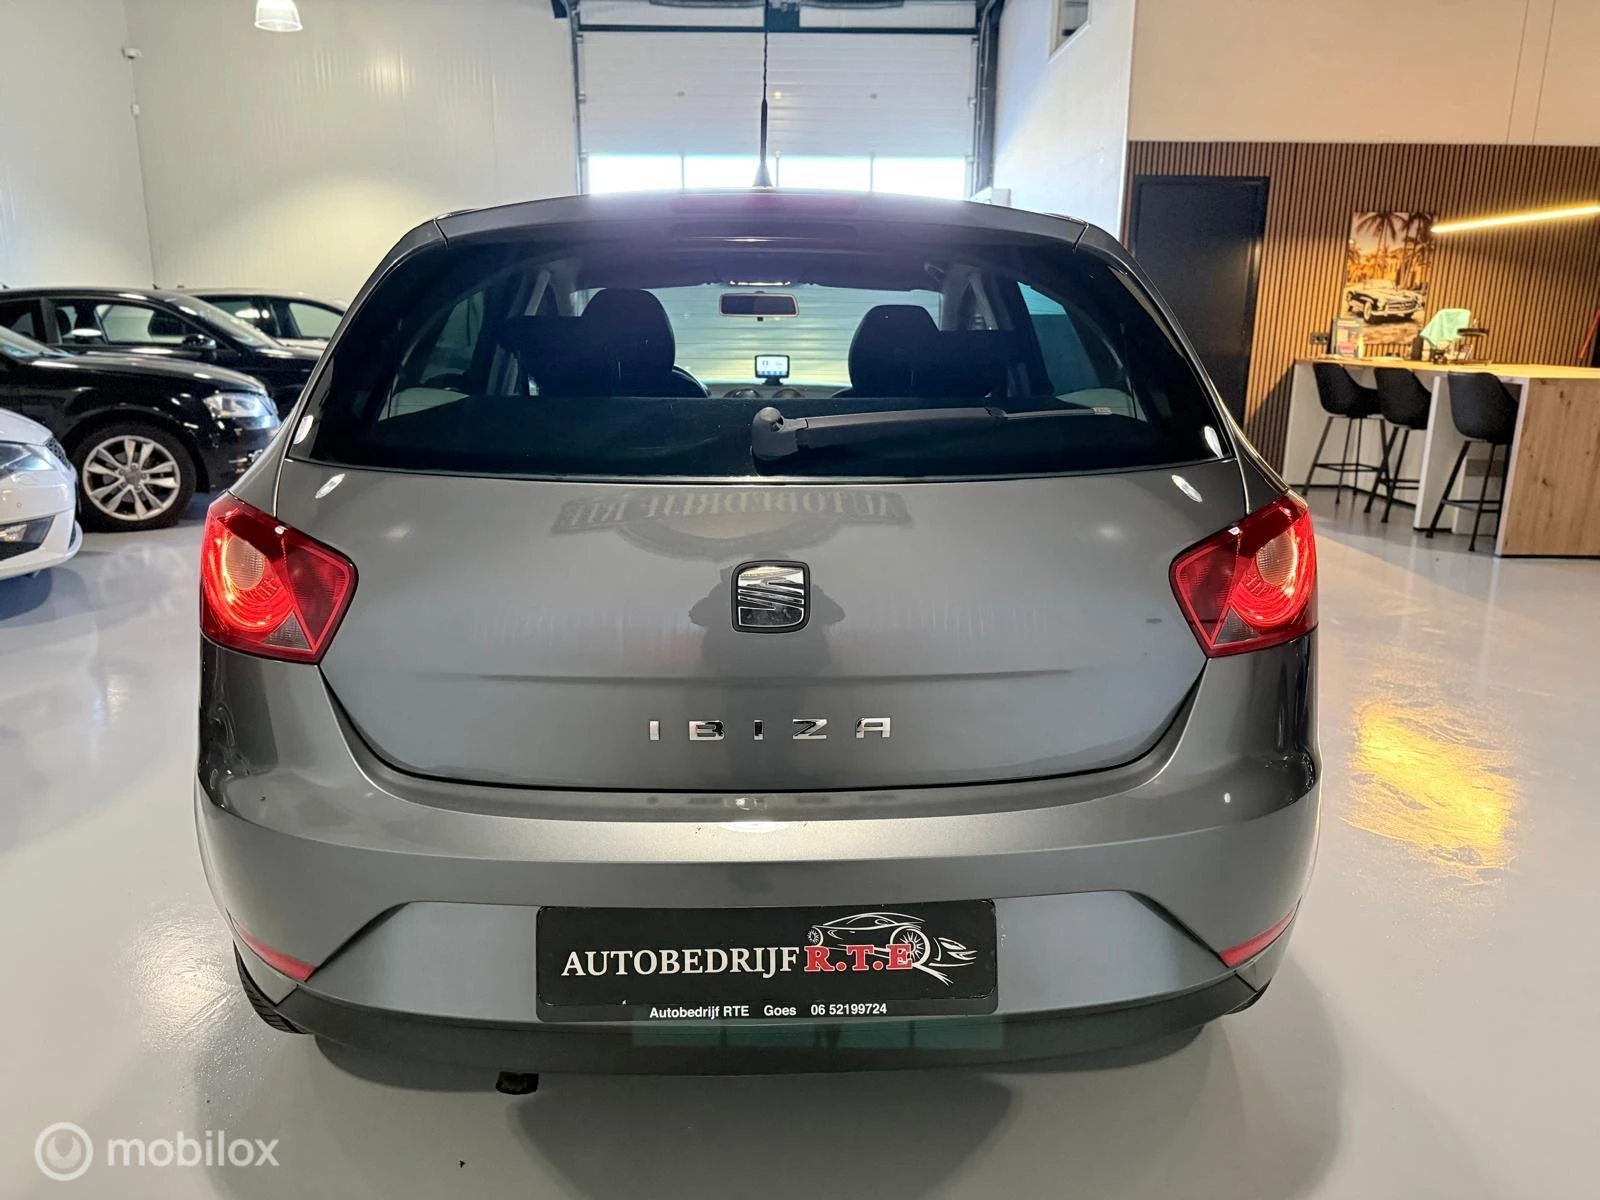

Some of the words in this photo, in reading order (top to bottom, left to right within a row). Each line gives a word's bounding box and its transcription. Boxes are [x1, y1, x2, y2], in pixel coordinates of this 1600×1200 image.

[649, 717, 892, 741] IBIZA
[562, 946, 800, 978] AUTOBEDRIJF
[649, 1005, 720, 1020] Autobedrijf
[723, 1005, 750, 1018] RTE
[763, 1004, 797, 1017] Goes
[810, 1004, 826, 1017] 06
[828, 1002, 888, 1016] 52199724
